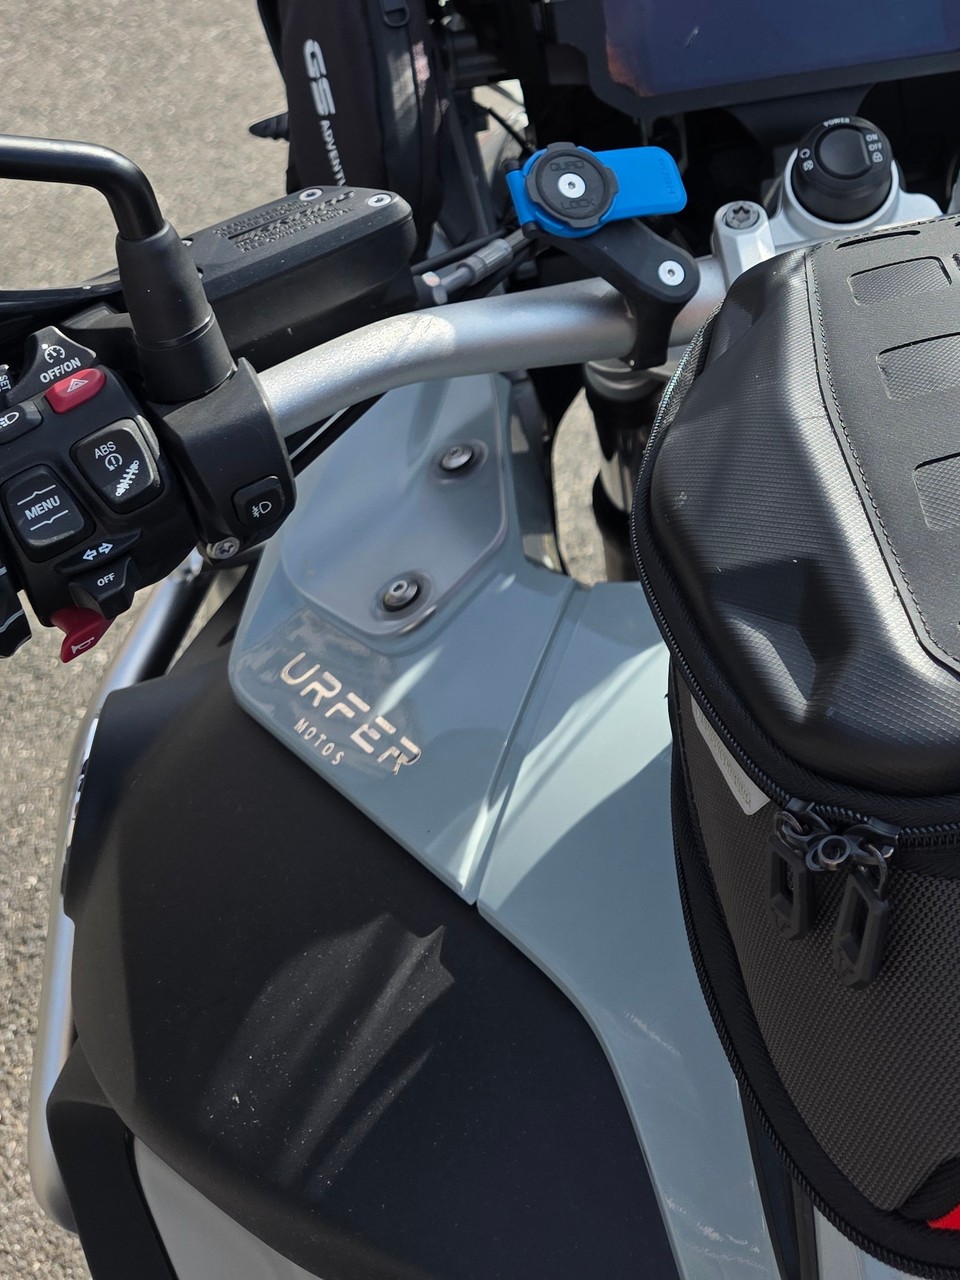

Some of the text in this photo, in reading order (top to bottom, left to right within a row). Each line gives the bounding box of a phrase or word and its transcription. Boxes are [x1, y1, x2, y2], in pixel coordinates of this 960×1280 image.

[304, 39, 336, 116] GS
[866, 133, 878, 141] ON
[868, 142, 882, 151] OFF
[551, 160, 585, 171] QUAD
[560, 198, 596, 209] LOCK
[39, 357, 82, 384] OFF/ON
[0, 374, 12, 391] SET
[94, 441, 117, 459] ABS
[24, 495, 61, 521] MENU
[96, 572, 116, 587] OFF
[280, 651, 422, 776] URFER
[293, 717, 345, 766] MOTOS
